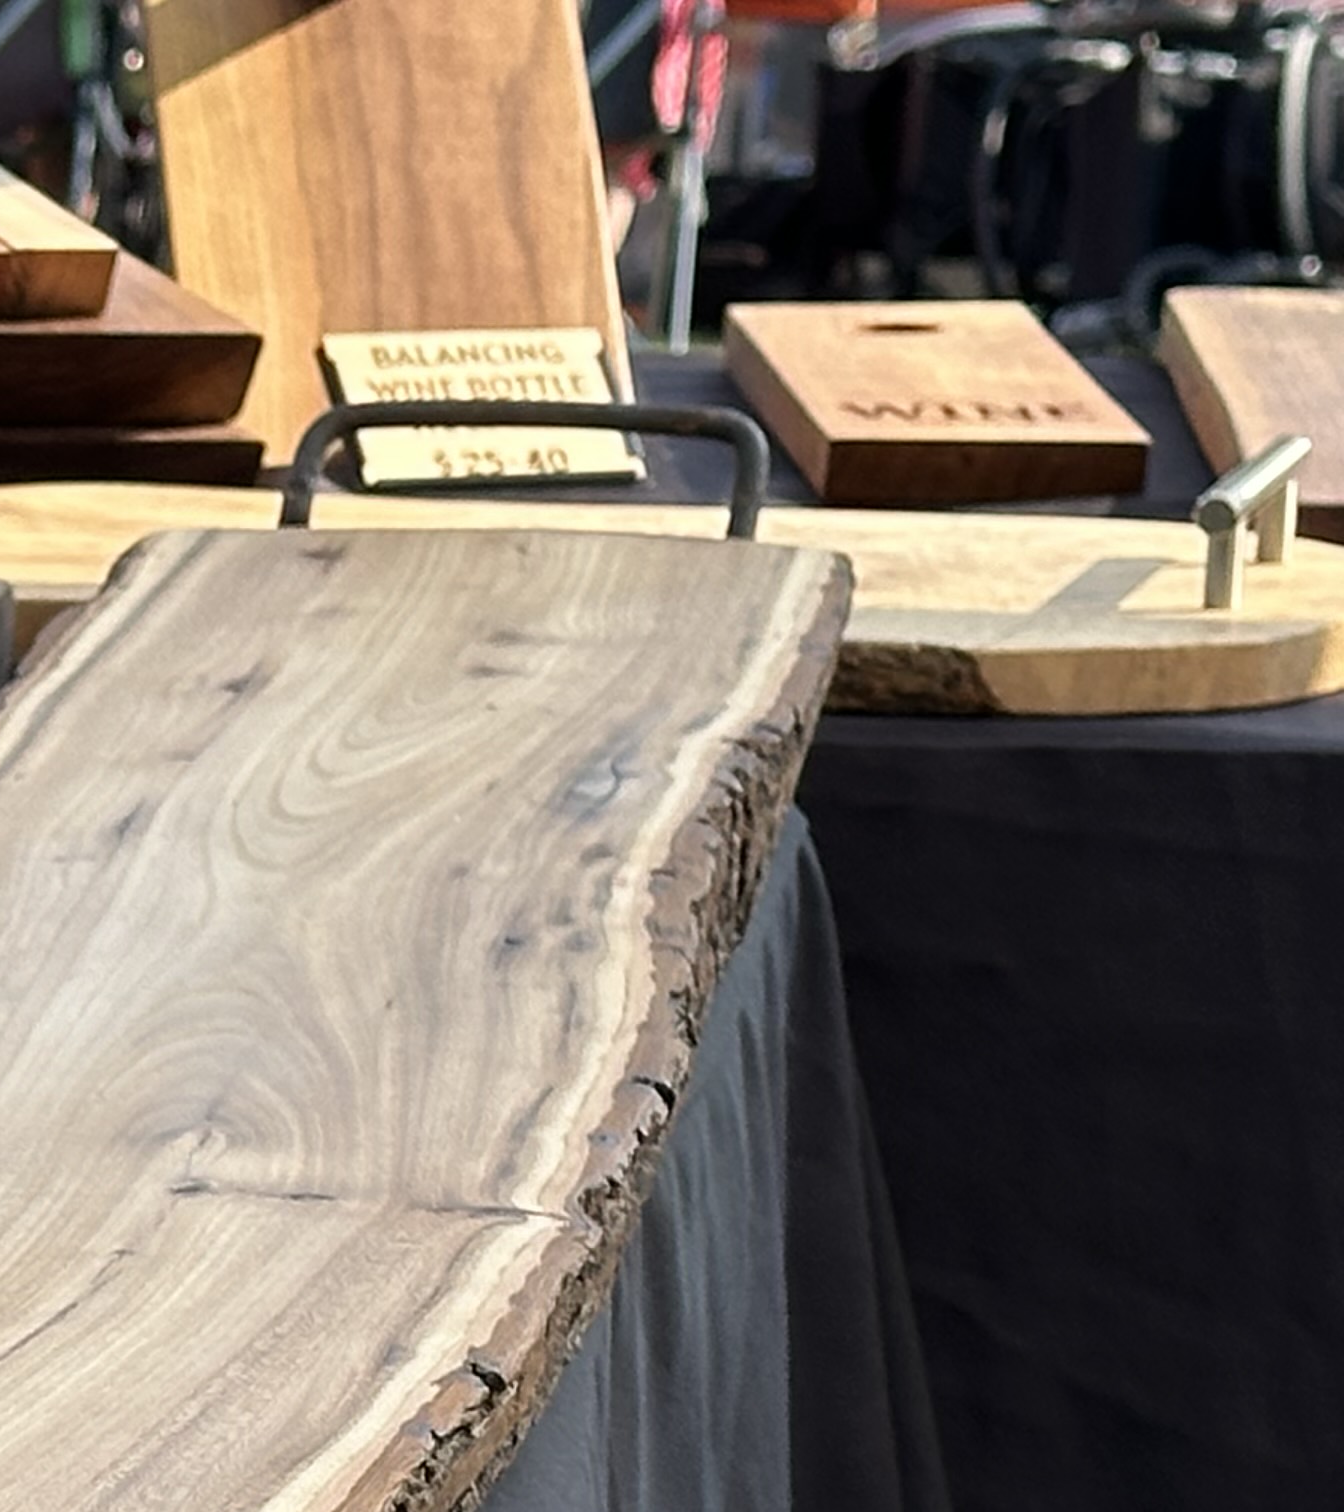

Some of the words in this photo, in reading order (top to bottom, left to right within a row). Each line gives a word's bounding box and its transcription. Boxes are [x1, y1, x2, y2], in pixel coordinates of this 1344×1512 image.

[368, 340, 566, 369] BALANCING
[365, 374, 454, 401] WINE
[838, 400, 1099, 423] WINE
